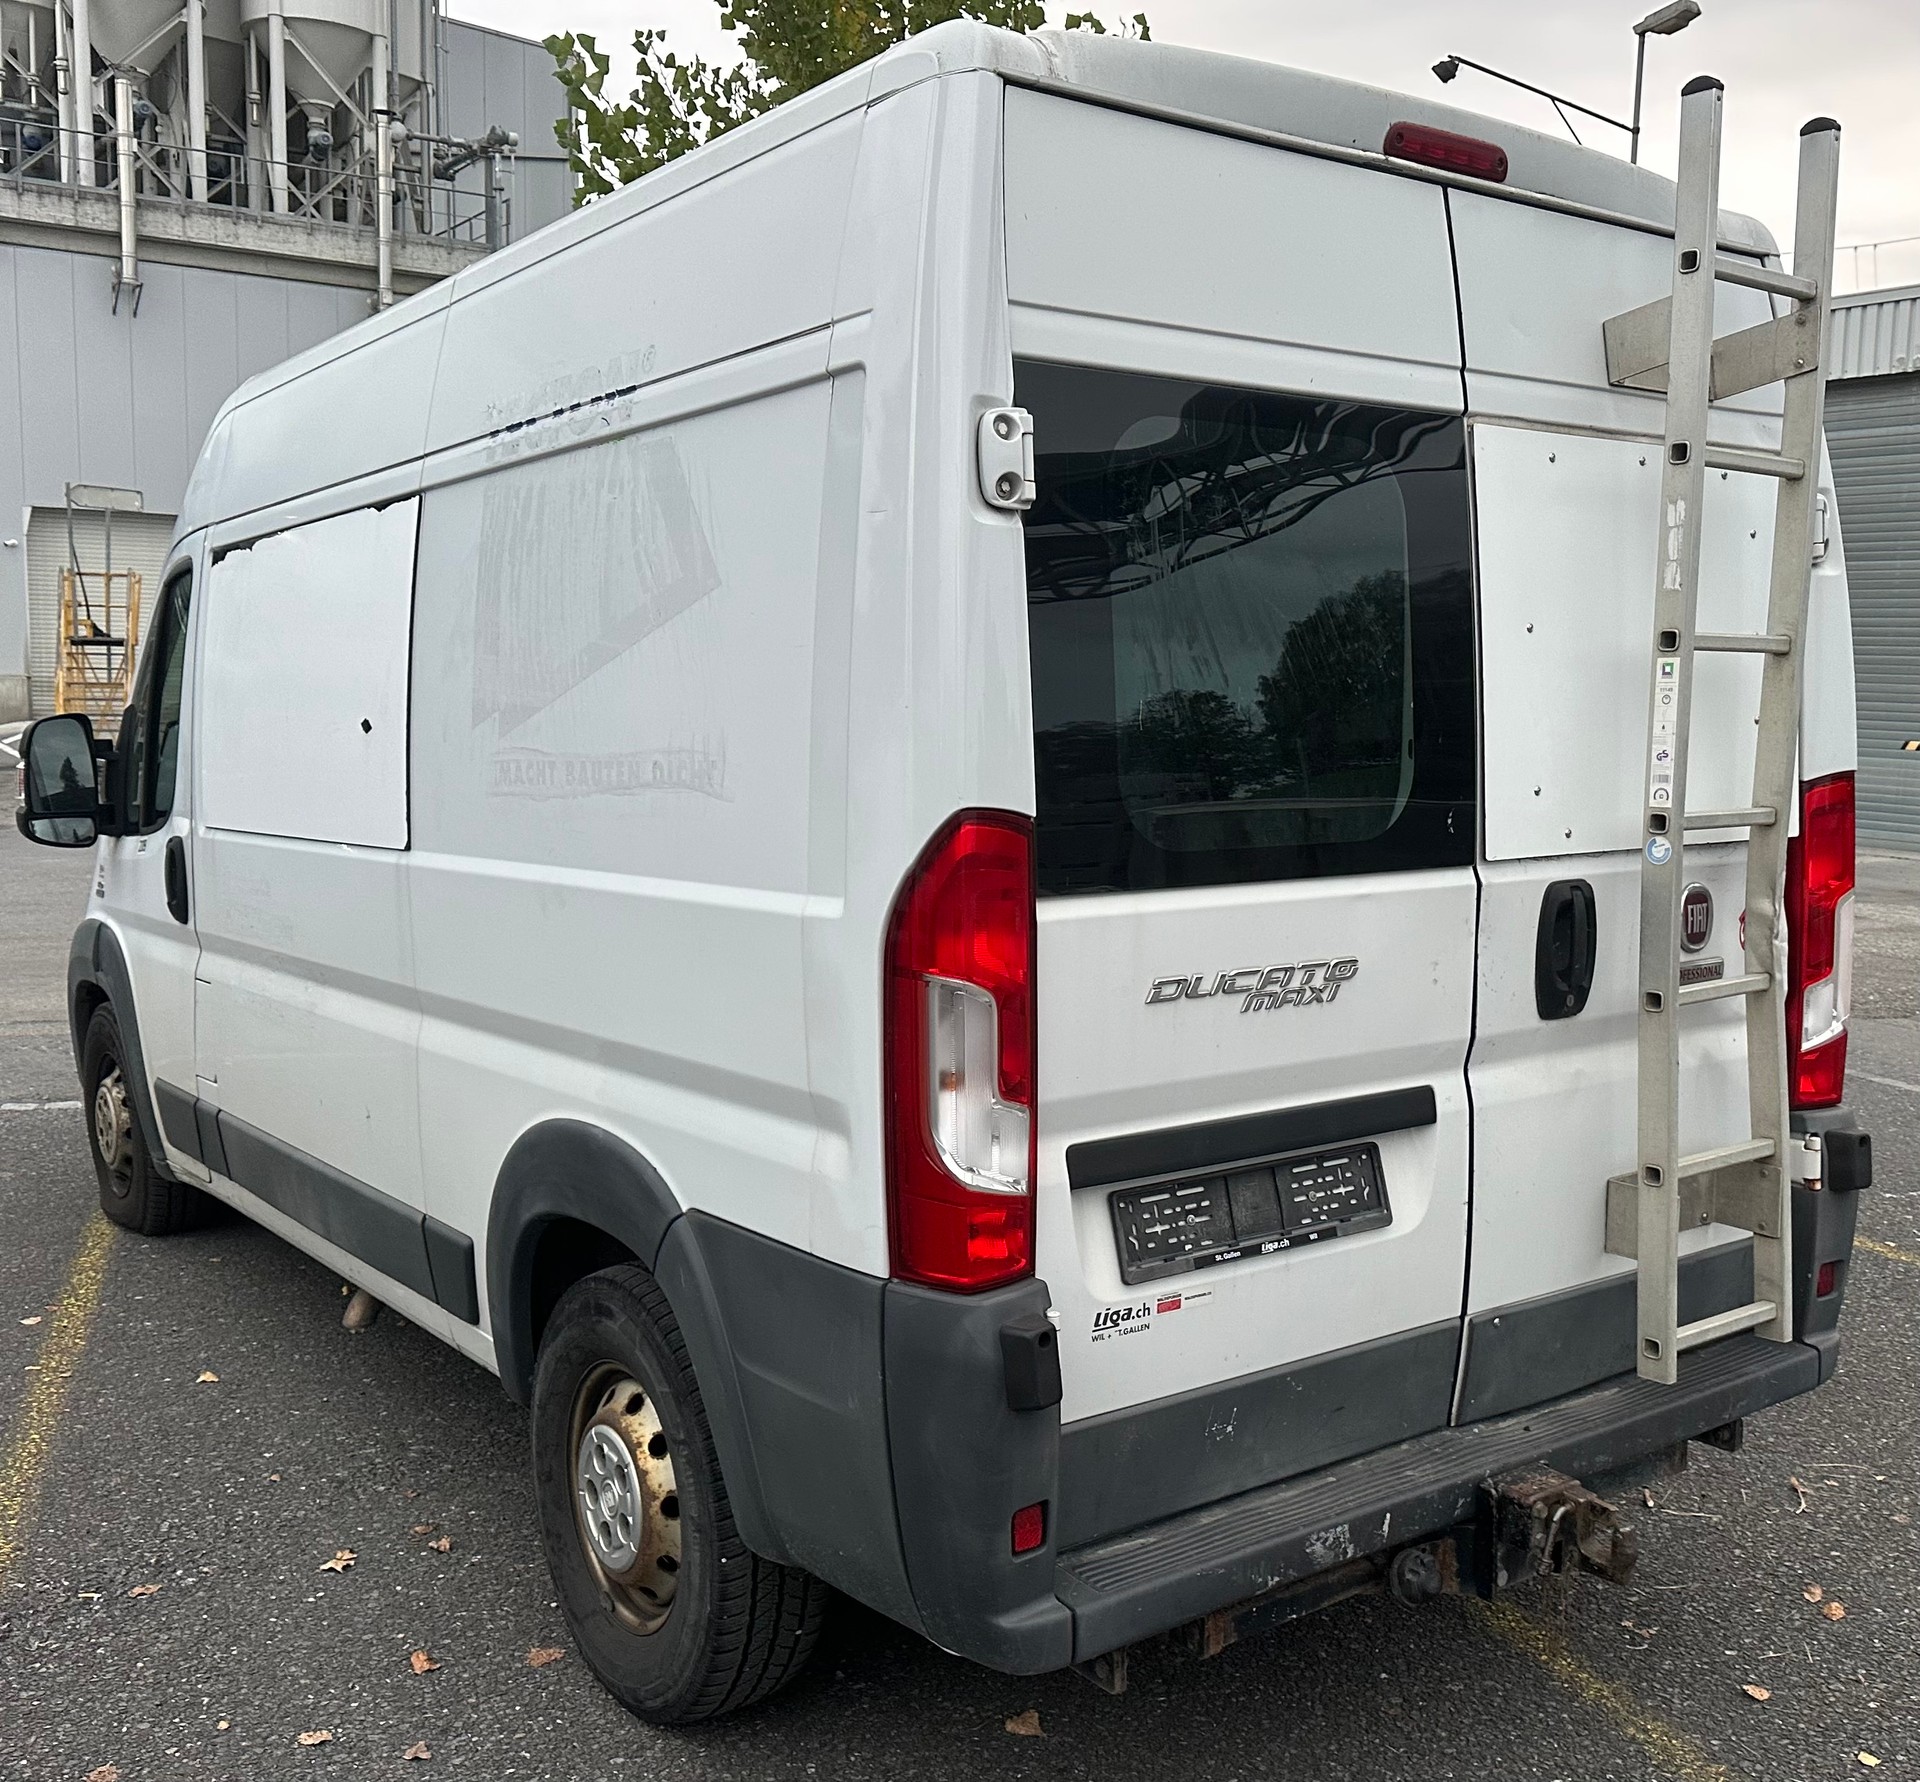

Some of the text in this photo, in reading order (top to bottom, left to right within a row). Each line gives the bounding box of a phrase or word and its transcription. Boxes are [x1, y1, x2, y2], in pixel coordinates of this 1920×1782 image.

[1687, 903, 1708, 934] FIAT
[1145, 956, 1359, 1004] DUCATO
[1680, 964, 1722, 981] FESSIONAL
[1240, 982, 1341, 1013] MAXI
[1261, 1238, 1290, 1254] Liga.ch
[1092, 1302, 1151, 1332] Liga.ch
[1091, 1333, 1105, 1342] WIL
[1115, 1323, 1150, 1337] T.GALLEN
